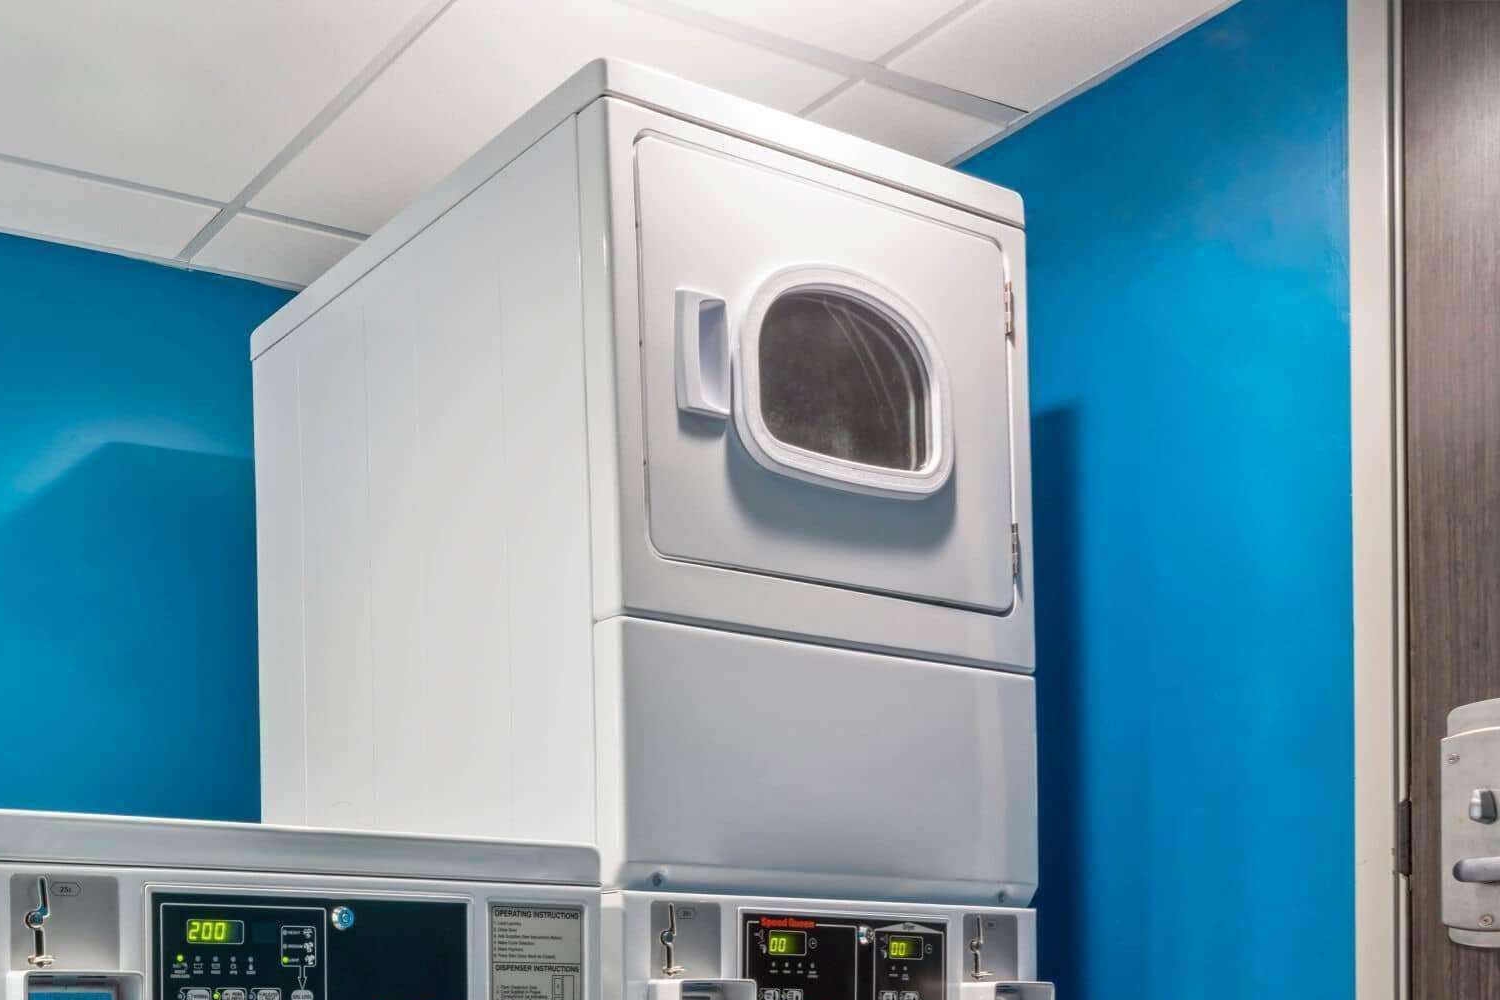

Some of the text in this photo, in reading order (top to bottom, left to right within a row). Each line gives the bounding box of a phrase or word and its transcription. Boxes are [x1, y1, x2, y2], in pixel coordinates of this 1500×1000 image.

[533, 911, 579, 920] INSTRUCTIONS
[188, 922, 226, 940] 200
[770, 937, 787, 953] 00
[891, 942, 906, 956] 00
